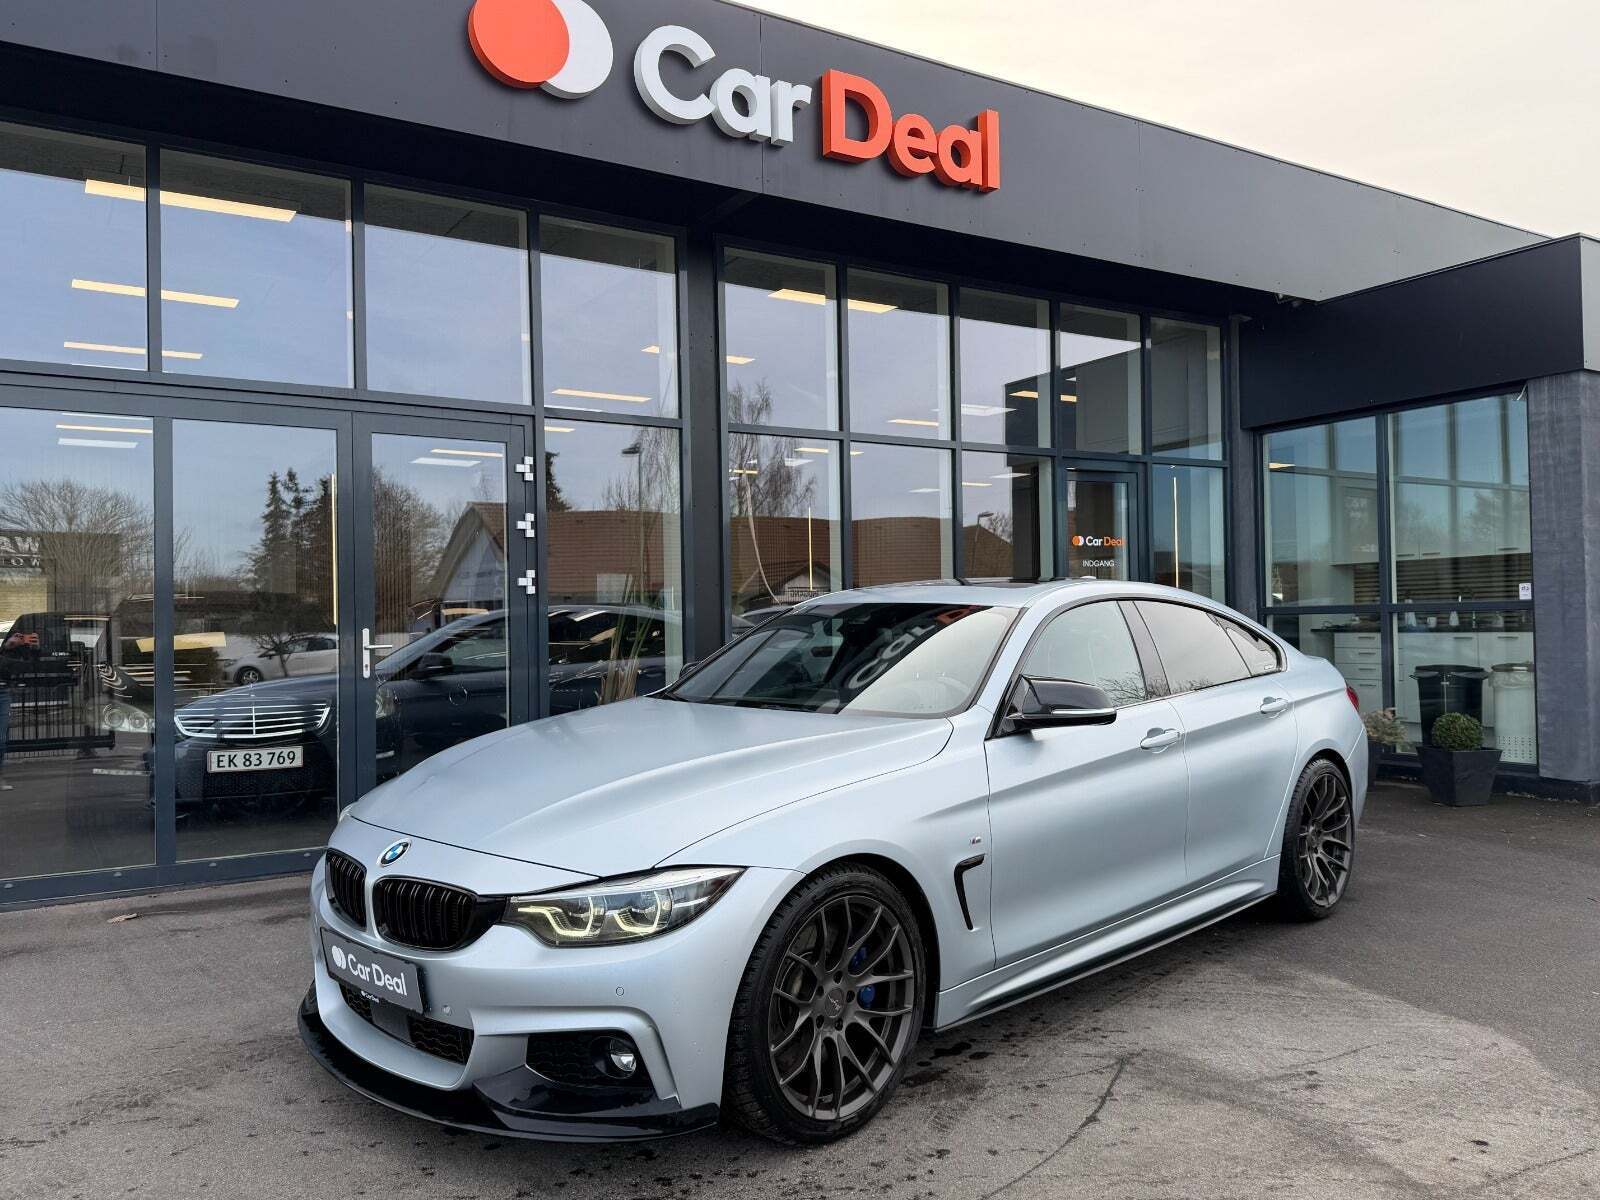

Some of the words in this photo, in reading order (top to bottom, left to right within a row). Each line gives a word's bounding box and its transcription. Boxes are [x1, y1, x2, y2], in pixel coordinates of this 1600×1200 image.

[634, 25, 812, 146] Car
[820, 69, 1000, 192] Deal
[1086, 536, 1103, 546] Car
[217, 755, 238, 768] EK
[243, 753, 262, 767] 83
[267, 751, 296, 765] 769
[348, 954, 370, 982] Car
[371, 963, 407, 995] Deal
